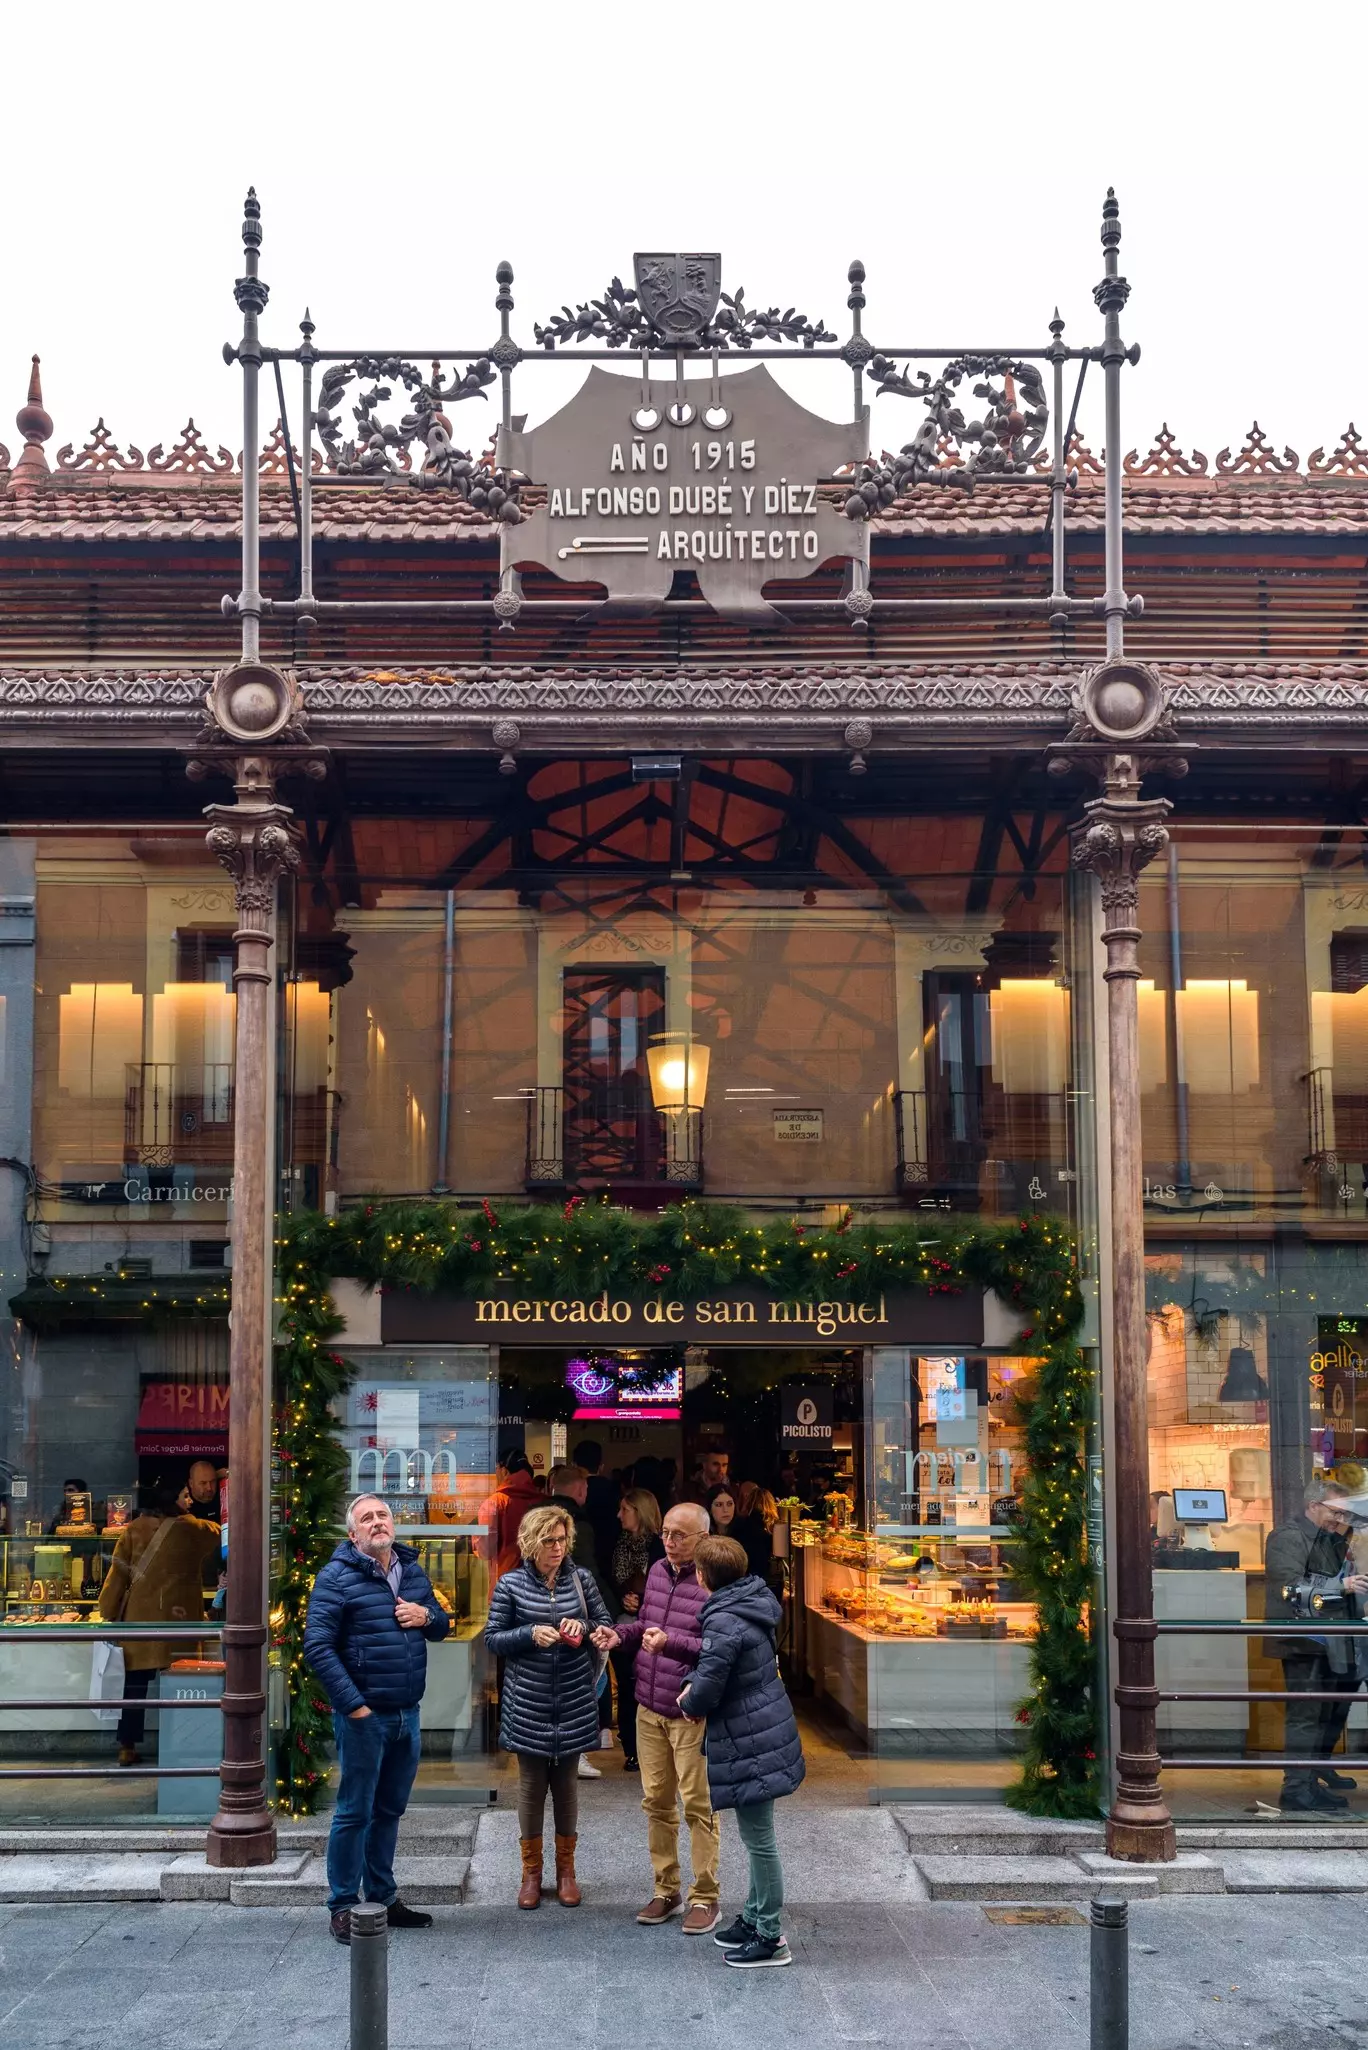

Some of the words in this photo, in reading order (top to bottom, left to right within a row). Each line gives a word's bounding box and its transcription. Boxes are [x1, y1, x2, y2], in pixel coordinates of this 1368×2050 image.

[610, 436, 668, 472] AÑO
[691, 439, 756, 471] 1915
[550, 487, 661, 517] ALFONSO
[669, 477, 733, 515] DUBÉ
[741, 486, 755, 515] Y
[475, 1290, 632, 1323] mercado
[643, 1292, 685, 1323] de
[695, 1300, 758, 1323] san
[767, 1292, 889, 1336] miguel
[803, 1404, 812, 1419] P
[783, 1425, 832, 1438] PICOLISTO
